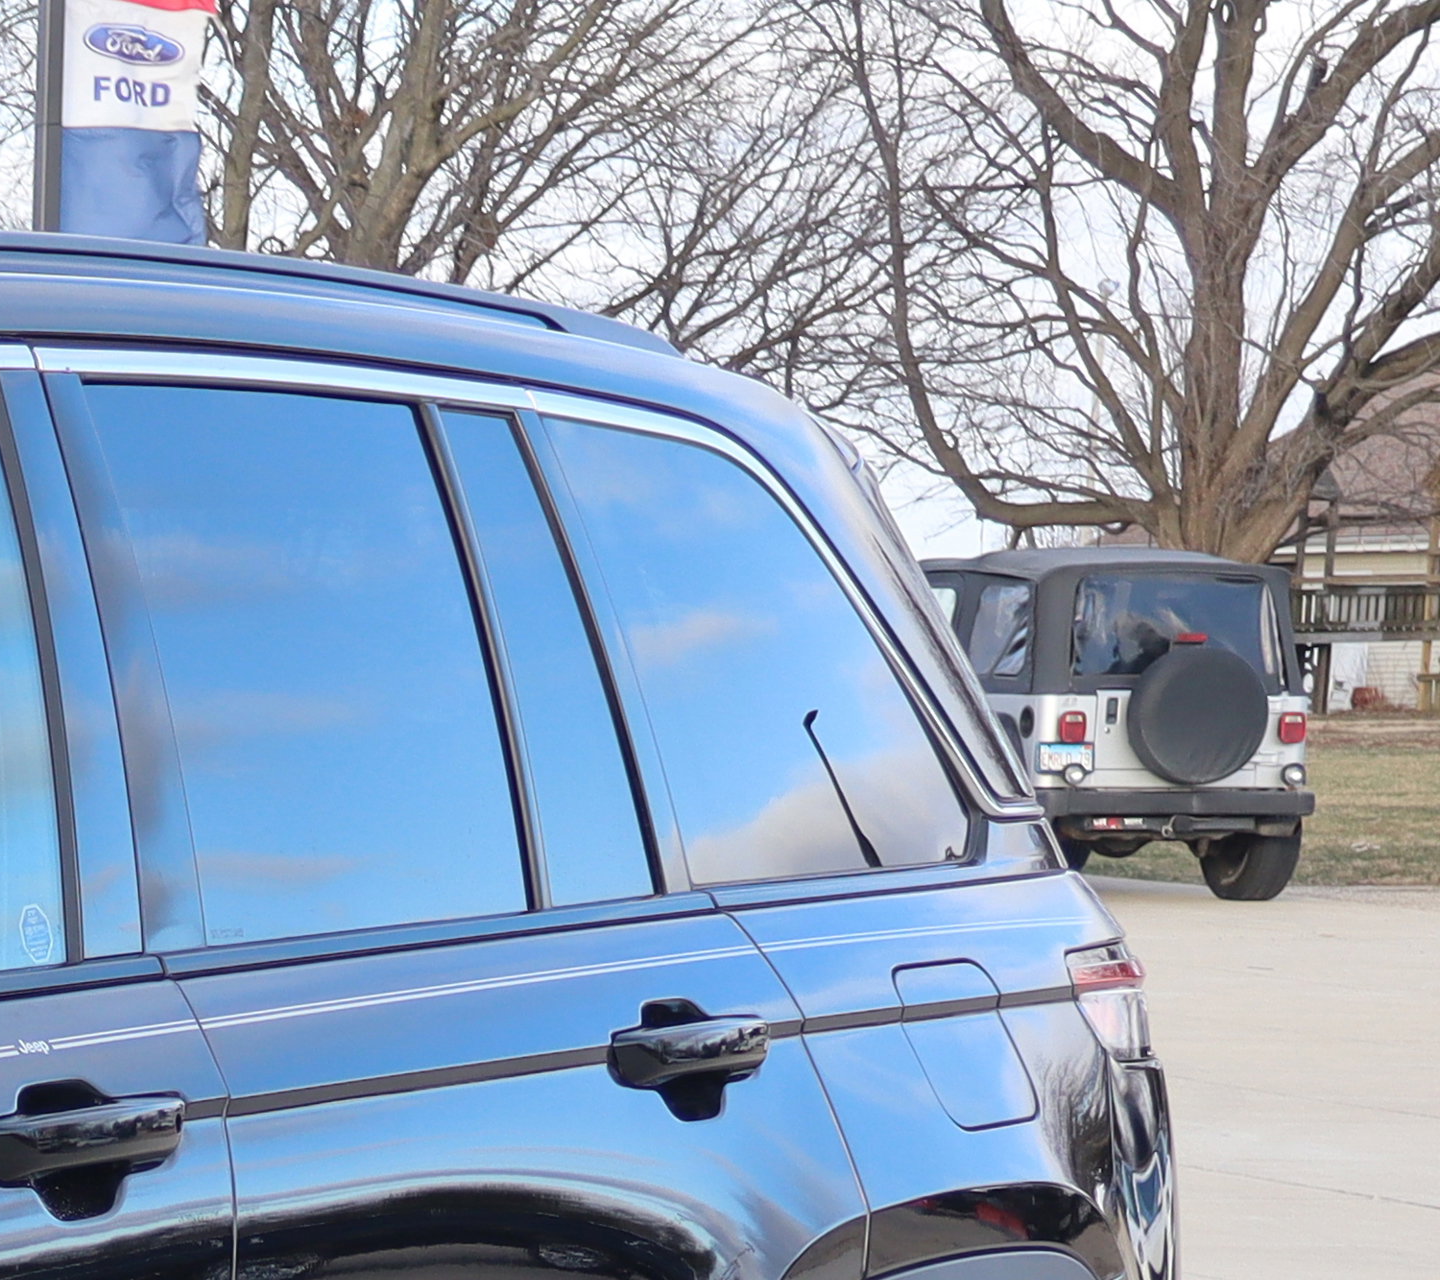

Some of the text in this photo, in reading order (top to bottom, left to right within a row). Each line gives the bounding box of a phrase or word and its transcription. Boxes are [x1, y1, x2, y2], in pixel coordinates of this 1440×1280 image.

[105, 29, 163, 63] Ford
[93, 76, 171, 107] FORD
[18, 1039, 50, 1055] Jeep
